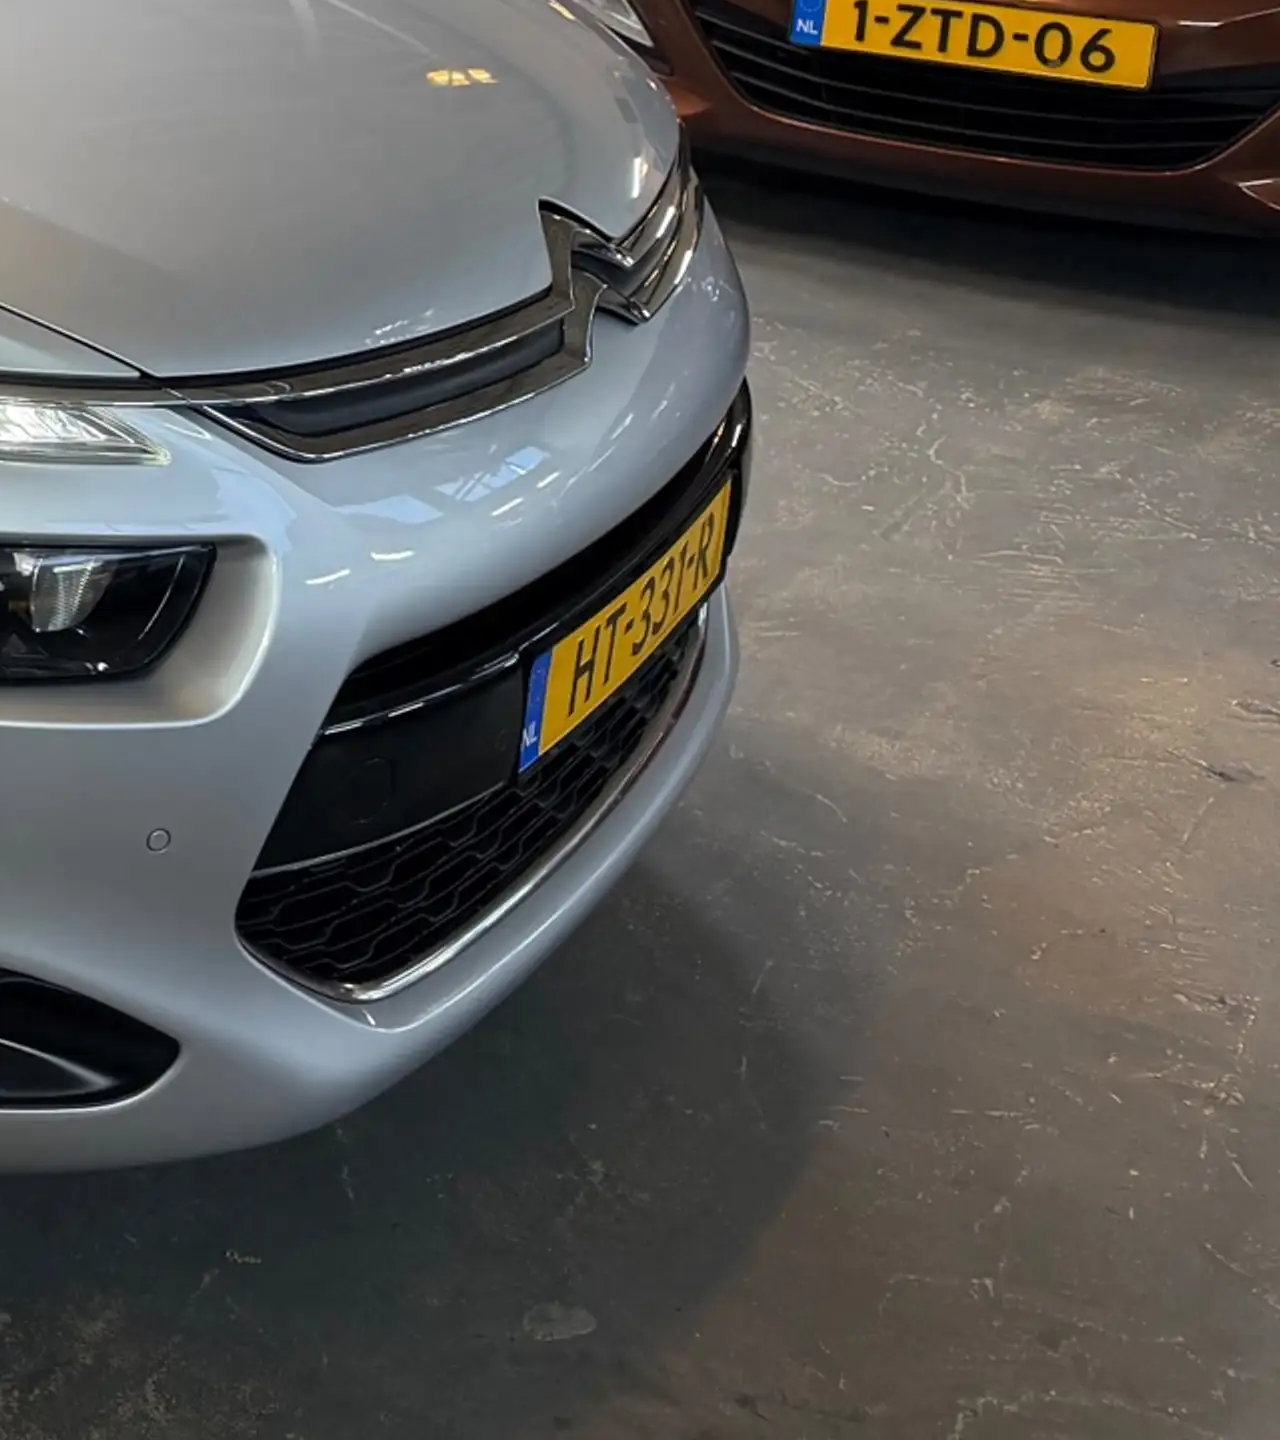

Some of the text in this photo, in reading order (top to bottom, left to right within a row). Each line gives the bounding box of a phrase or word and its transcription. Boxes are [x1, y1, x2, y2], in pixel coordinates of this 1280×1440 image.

[796, 18, 819, 36] NL
[522, 511, 715, 747] NL HT-331-R
